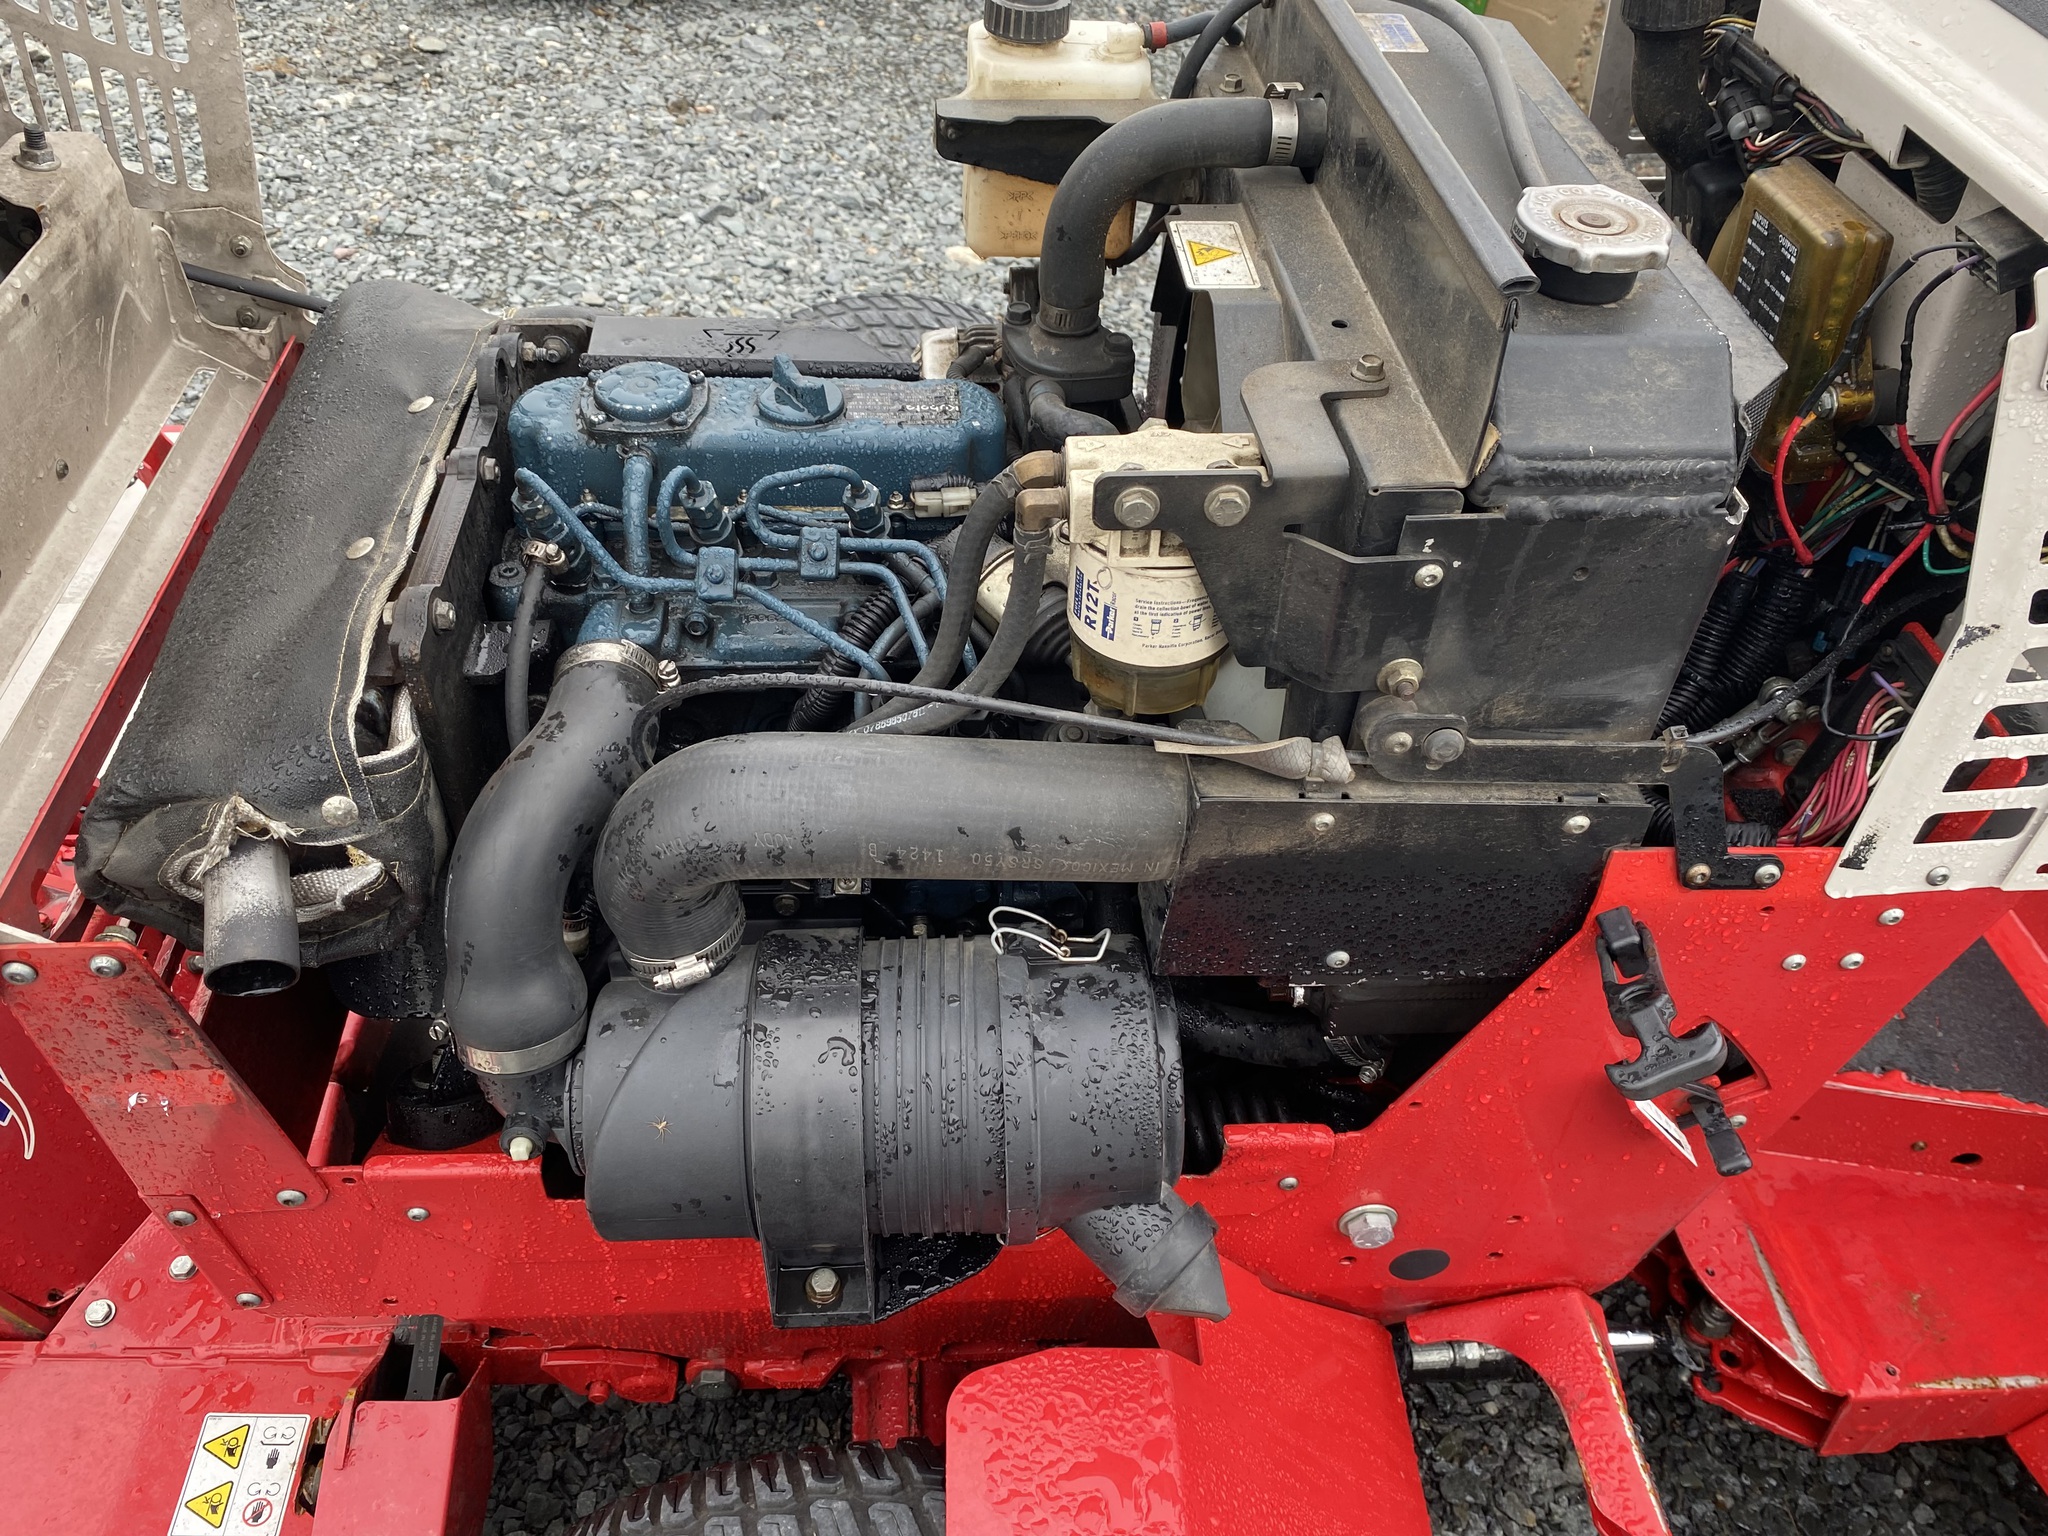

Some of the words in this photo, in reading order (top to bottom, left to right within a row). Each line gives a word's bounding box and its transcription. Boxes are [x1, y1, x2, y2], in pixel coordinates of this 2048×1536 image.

[905, 403, 959, 412] Kubota
[1084, 579, 1100, 630] R12T
[1105, 608, 1116, 636] Parker
[1143, 861, 1159, 872] IN
